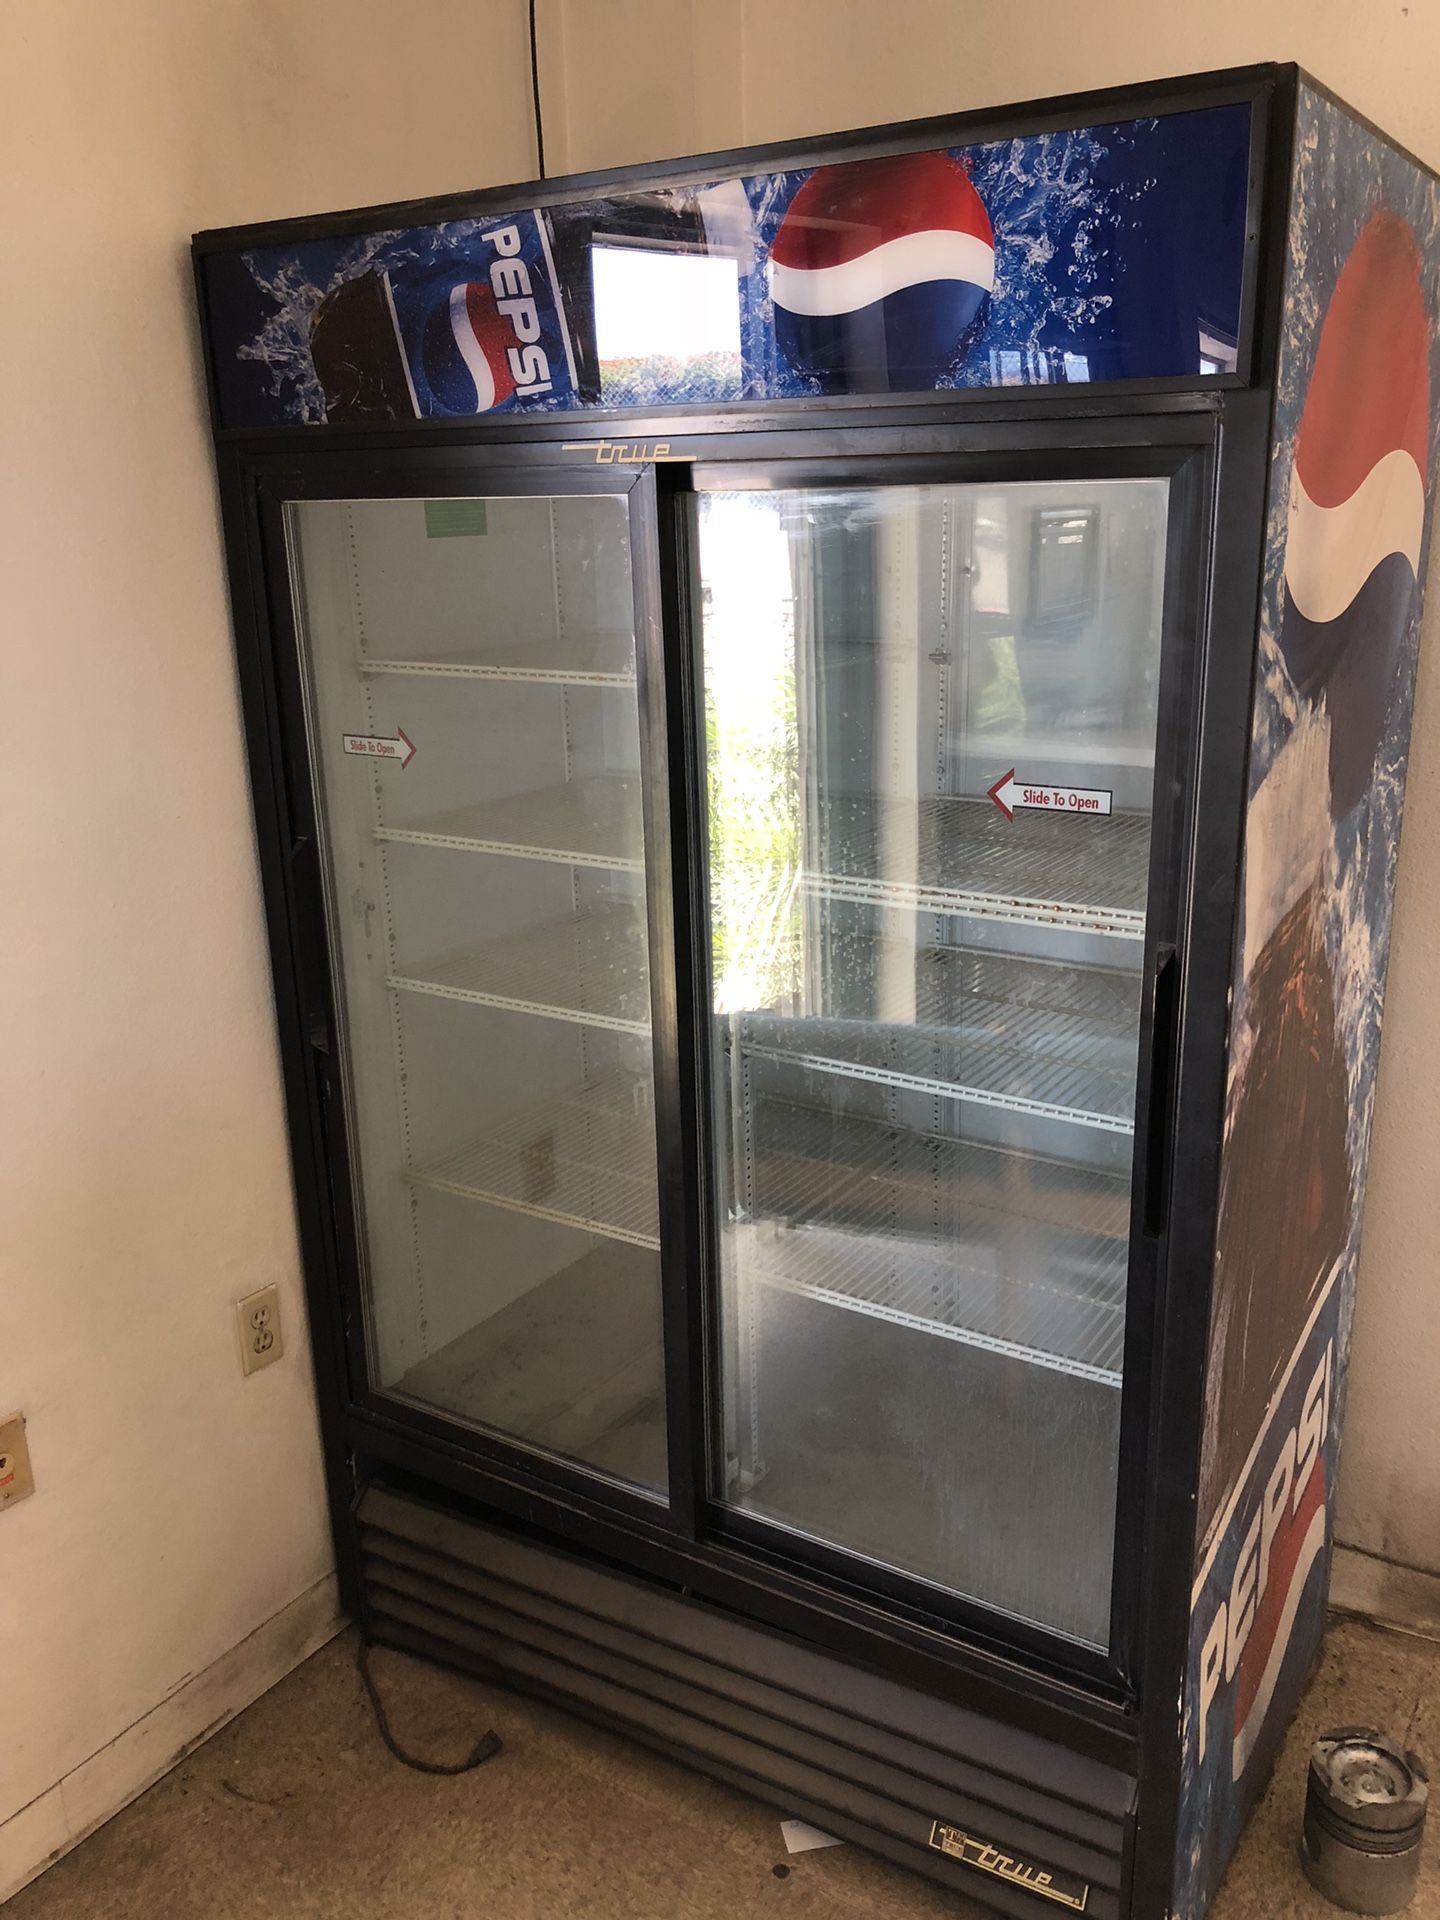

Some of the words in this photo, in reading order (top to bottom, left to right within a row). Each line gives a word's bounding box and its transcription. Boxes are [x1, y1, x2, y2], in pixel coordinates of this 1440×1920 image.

[481, 224, 554, 397] PEPSI
[350, 739, 367, 751] Slide
[368, 741, 375, 752] To
[377, 742, 396, 755] Open
[1023, 790, 1050, 805] Slide
[1053, 792, 1065, 806] To
[1068, 794, 1099, 810] Open
[1198, 1338, 1334, 1766] PEPSI
